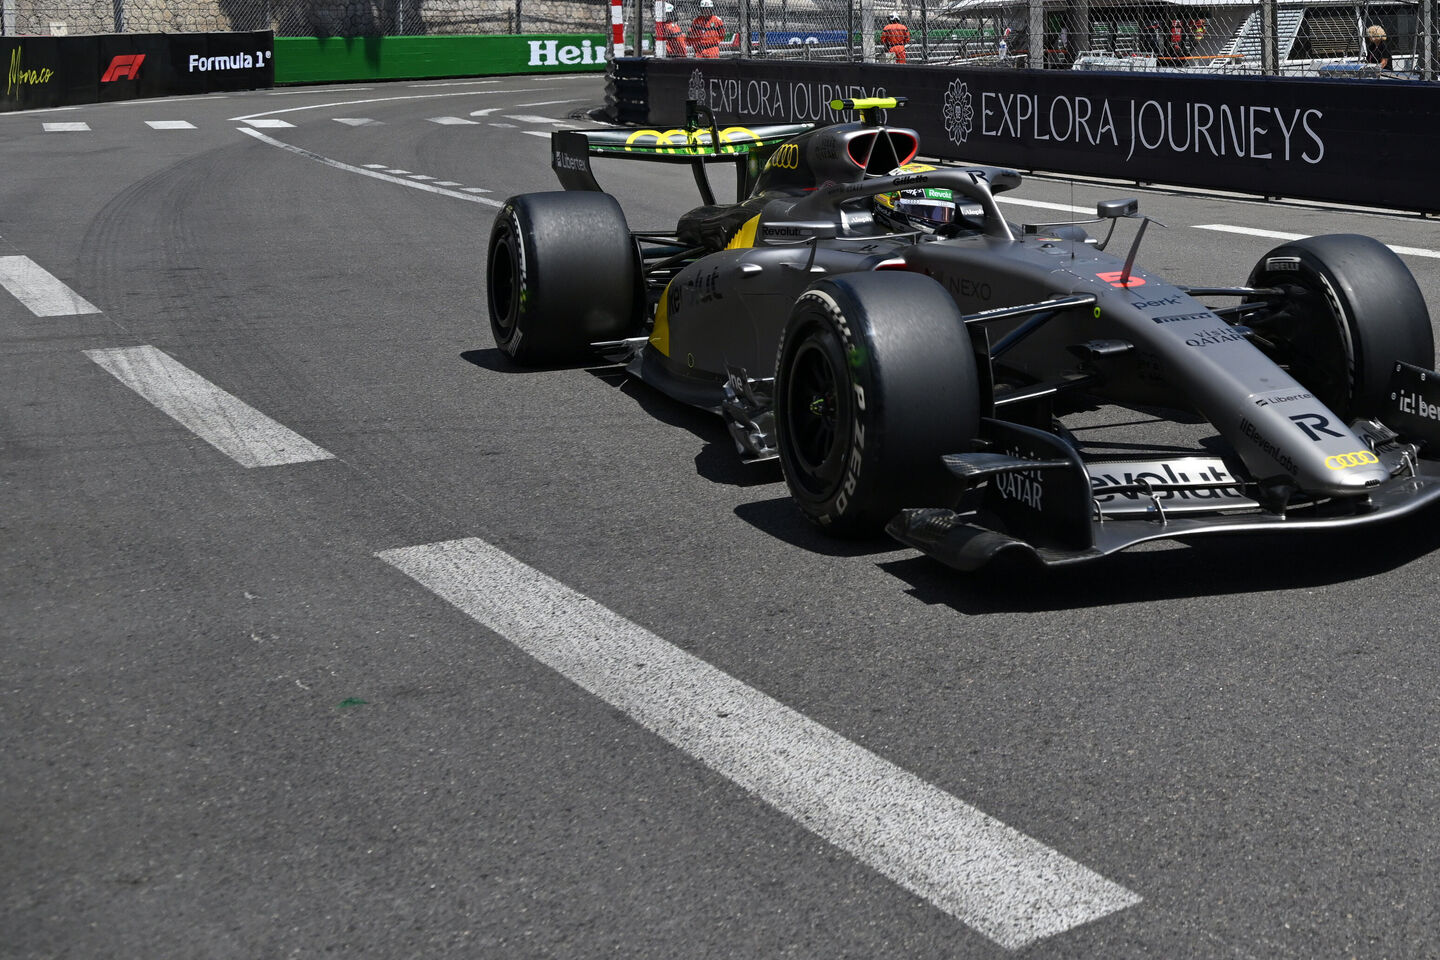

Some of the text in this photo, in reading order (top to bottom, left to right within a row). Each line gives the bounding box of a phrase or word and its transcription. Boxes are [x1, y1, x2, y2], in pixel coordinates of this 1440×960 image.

[189, 51, 253, 73] Formula
[7, 45, 54, 101] Monaco
[709, 79, 785, 117] EXPLORA
[981, 92, 1325, 165] EXPLORA JOURNEYS
[893, 174, 929, 186] Gillette
[850, 215, 872, 223] Aleph
[762, 226, 799, 236] Revolut
[1266, 257, 1301, 271] PIRELLI
[950, 277, 992, 300] NEXO
[1096, 271, 1147, 288] 5
[1152, 312, 1213, 324] PIRELLI
[1185, 333, 1245, 347] QATAR
[1194, 327, 1235, 338] visit
[1400, 389, 1416, 415] ic!
[836, 417, 865, 515] ZERO
[996, 472, 1043, 512] QATAR
